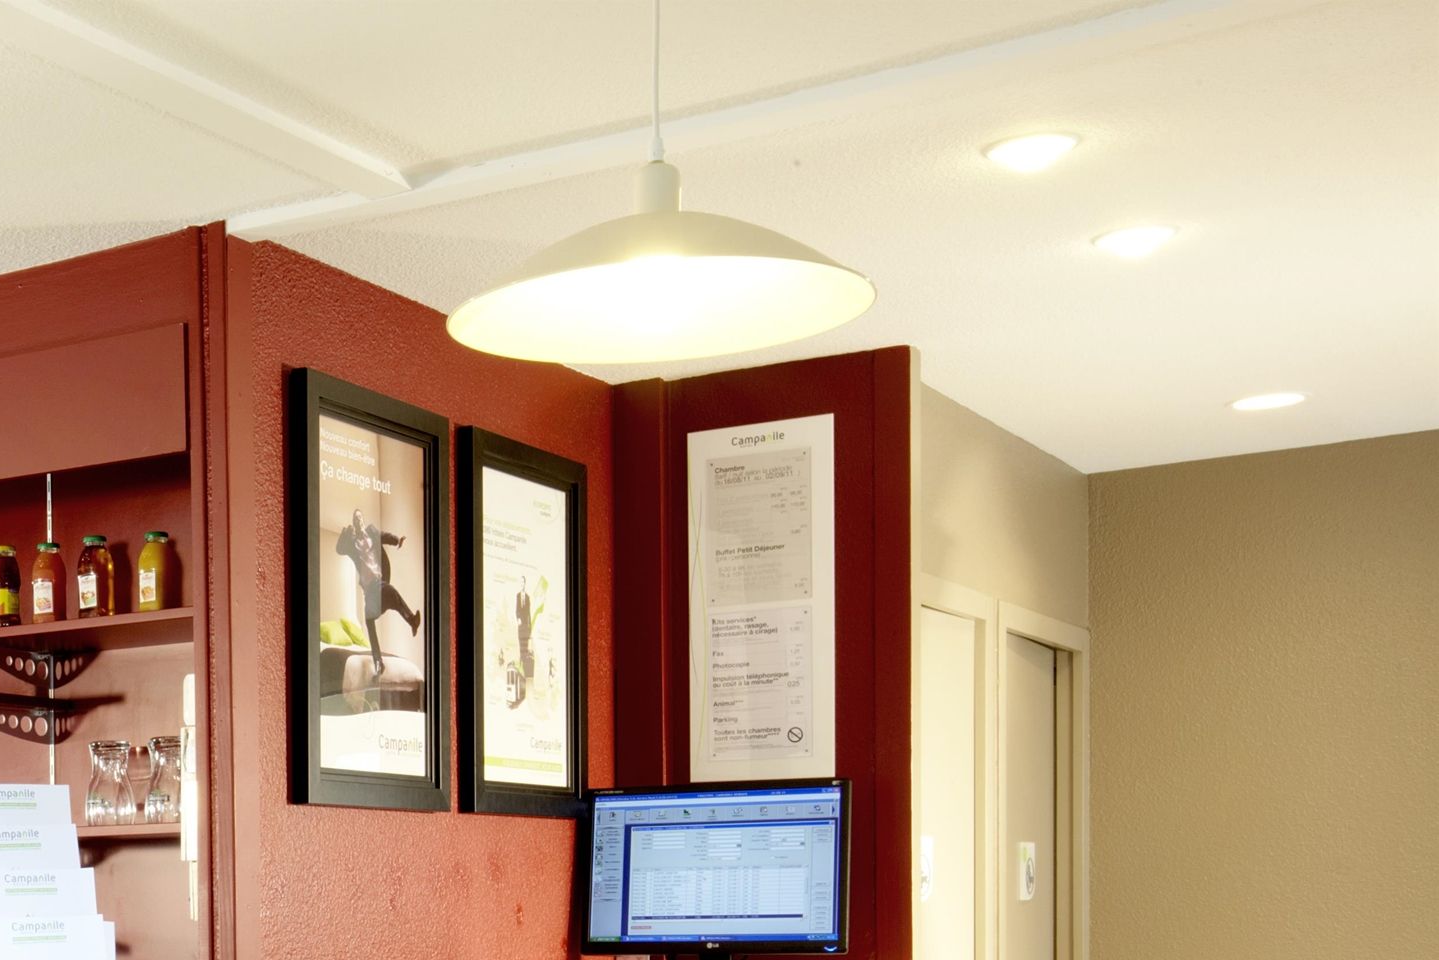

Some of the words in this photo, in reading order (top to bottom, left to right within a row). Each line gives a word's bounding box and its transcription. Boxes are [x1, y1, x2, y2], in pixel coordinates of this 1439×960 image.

[731, 432, 784, 447] Campanile
[715, 465, 745, 474] Chambre
[320, 460, 334, 480] Ça
[336, 467, 370, 490] change
[372, 476, 391, 494] tout
[746, 672, 789, 680] téléphonique
[378, 734, 423, 754] Campanile
[4, 874, 56, 885] Campanile
[11, 920, 65, 933] Campanile
